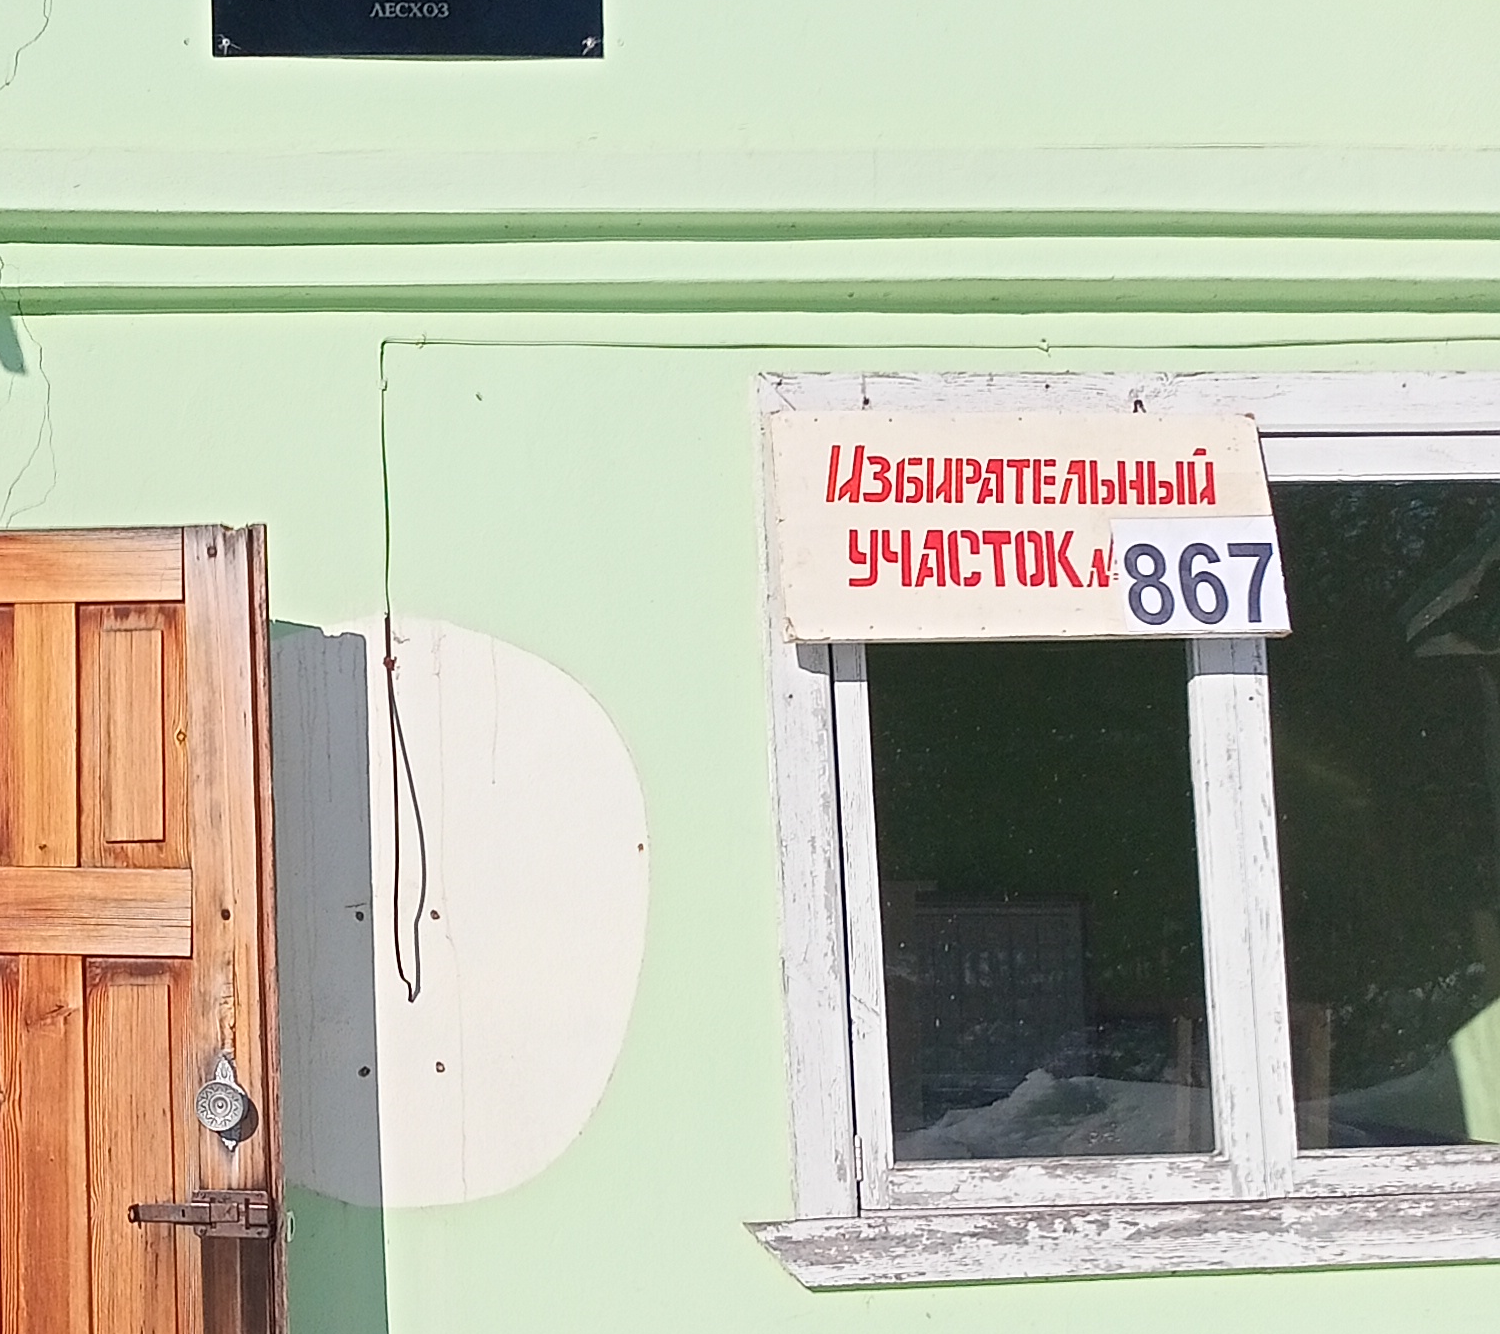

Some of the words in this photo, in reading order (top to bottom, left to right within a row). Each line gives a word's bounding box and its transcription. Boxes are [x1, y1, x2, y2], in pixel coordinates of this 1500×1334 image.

[370, 3, 450, 19] ЛЕСХОЗ
[825, 444, 1217, 505] ИЗБИРАТЕЛЬНЫЙ
[847, 529, 1084, 588] УЧАСТОК
[1123, 542, 1275, 626] 867
